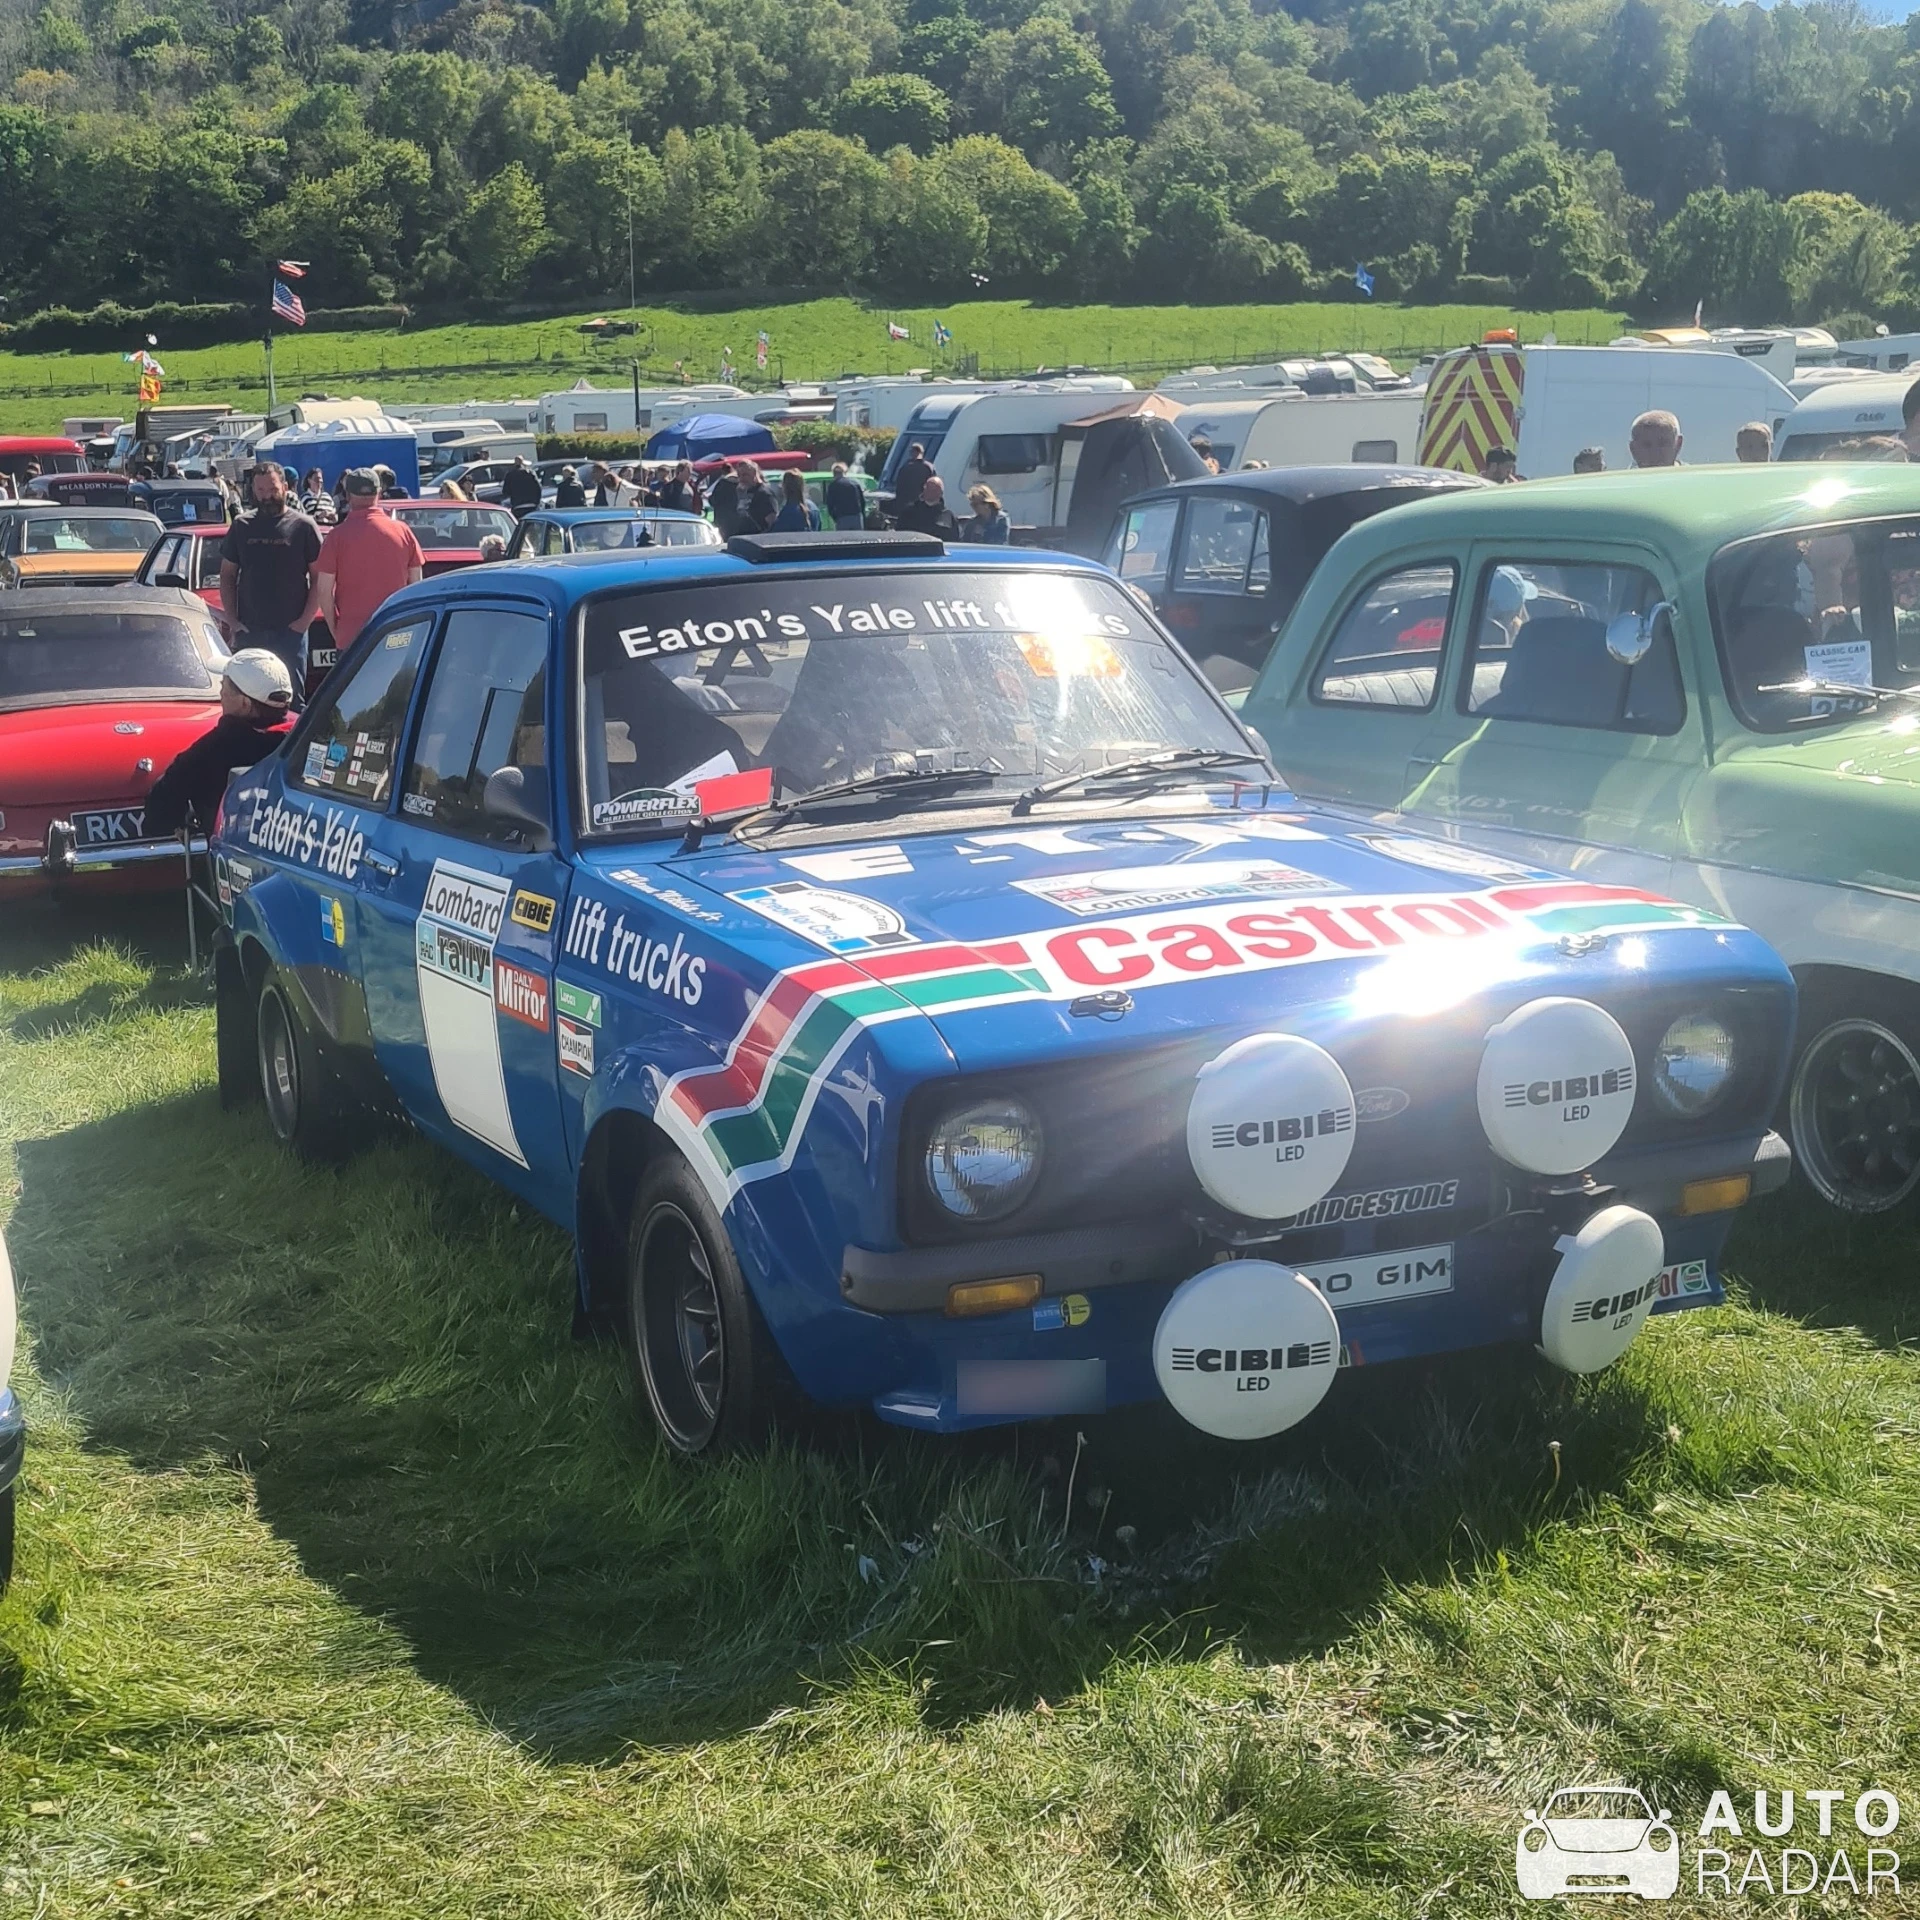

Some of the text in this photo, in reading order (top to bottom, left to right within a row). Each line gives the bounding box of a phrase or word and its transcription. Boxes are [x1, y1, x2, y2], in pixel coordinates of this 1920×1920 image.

[618, 608, 807, 659] Eaton's
[811, 599, 917, 634] Yale
[923, 600, 986, 628] lift
[1810, 645, 1867, 657] CLASSIC CAR
[594, 796, 699, 819] POWERFLEX
[86, 811, 146, 842] RKY
[248, 787, 318, 863] Eaton's
[318, 807, 363, 879] Yale
[425, 873, 505, 936] Lombard
[1068, 885, 1213, 913] Lombard
[565, 895, 608, 965] lift
[606, 913, 707, 1006] trucks
[1046, 896, 1514, 986] Castrol
[439, 936, 490, 984] rally
[514, 970, 534, 989] DAILY
[498, 965, 547, 1023] Mirror
[561, 1033, 592, 1063] CHAMPION
[1357, 1094, 1393, 1115] Ford
[1563, 1105, 1590, 1122] LED
[1276, 1145, 1305, 1163] LED
[1376, 1258, 1446, 1286] GIM
[1612, 1312, 1633, 1331] LED
[1236, 1377, 1270, 1392] LED
